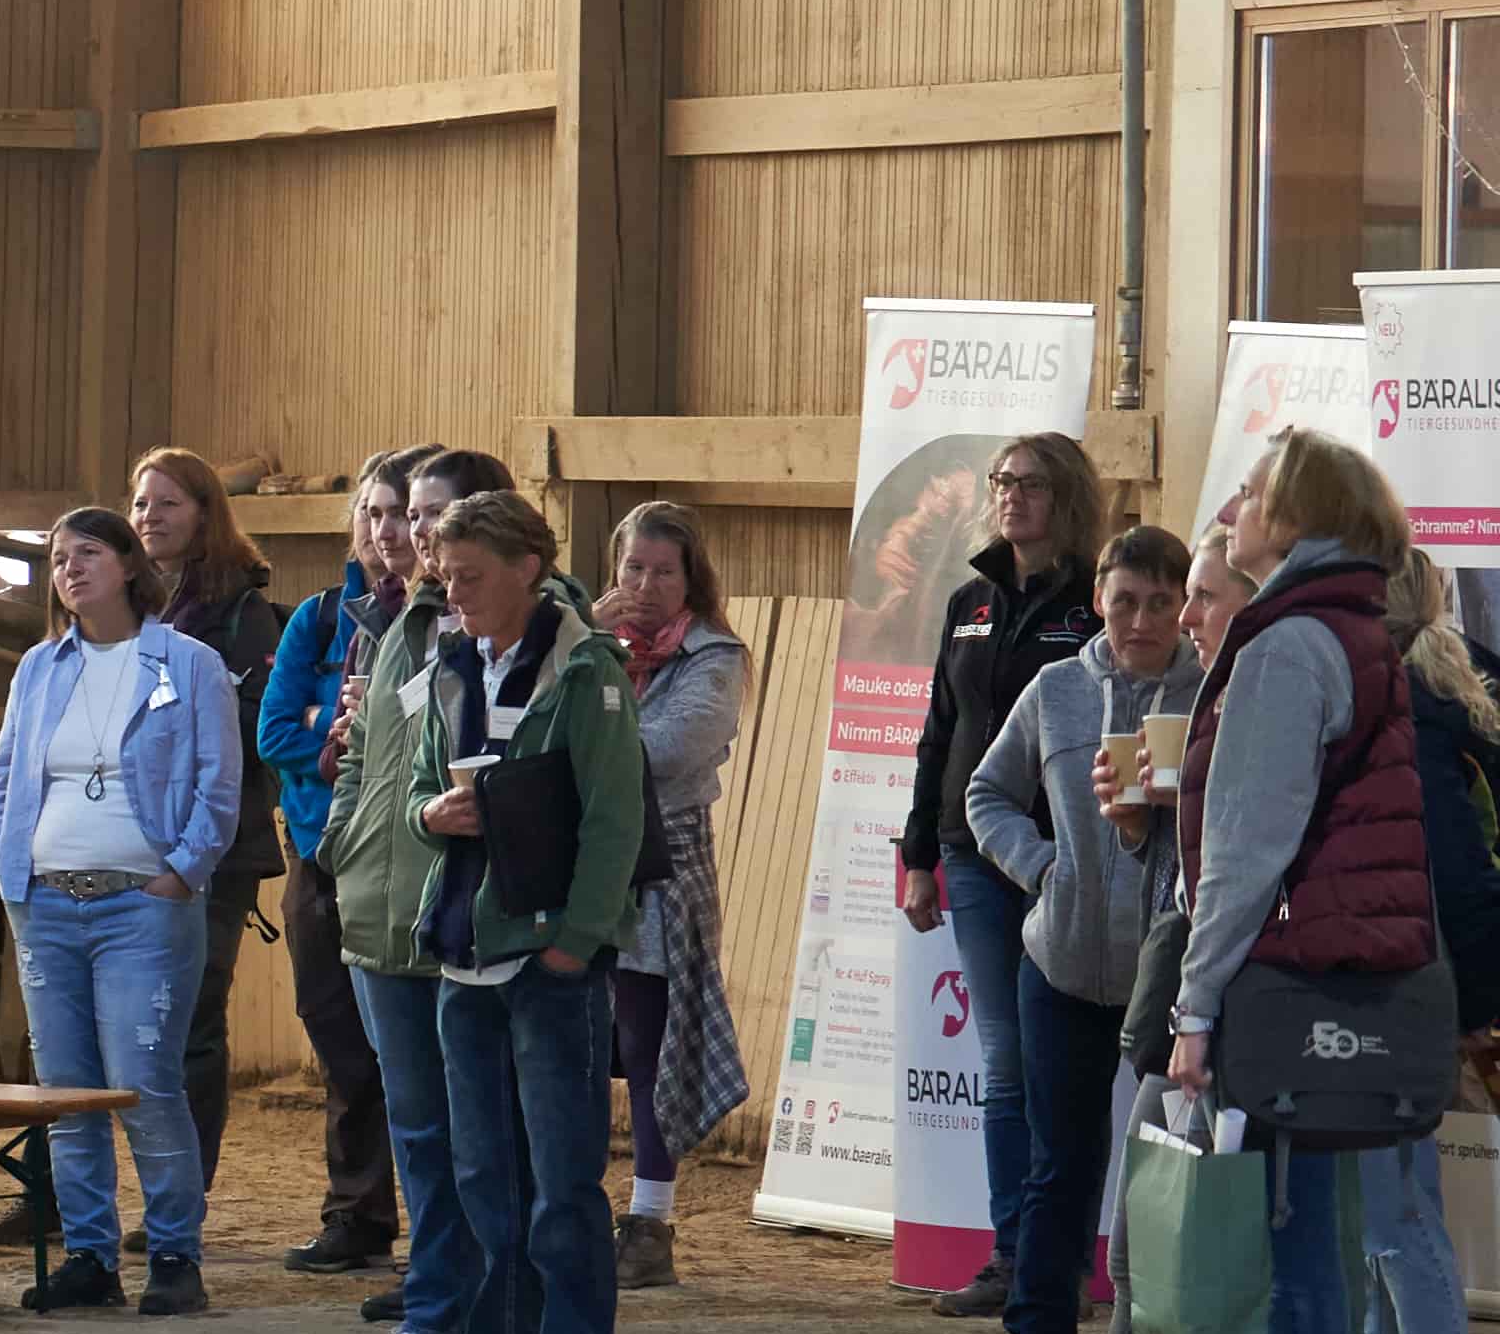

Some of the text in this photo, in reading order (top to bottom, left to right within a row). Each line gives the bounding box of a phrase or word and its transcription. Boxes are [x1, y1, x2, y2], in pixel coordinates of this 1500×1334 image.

[929, 339, 1061, 382] BÄRALIS
[927, 388, 1053, 409] TIERGESUNDHEIT
[1406, 417, 1500, 431] TIERGESUNDHE
[1477, 517, 1500, 534] Nim
[843, 674, 892, 696] Mauke
[893, 678, 924, 697] oder
[837, 720, 924, 746] Nimm BÄRA
[907, 1067, 987, 1108] BÄRAL
[908, 1110, 981, 1131] TIERGESUND
